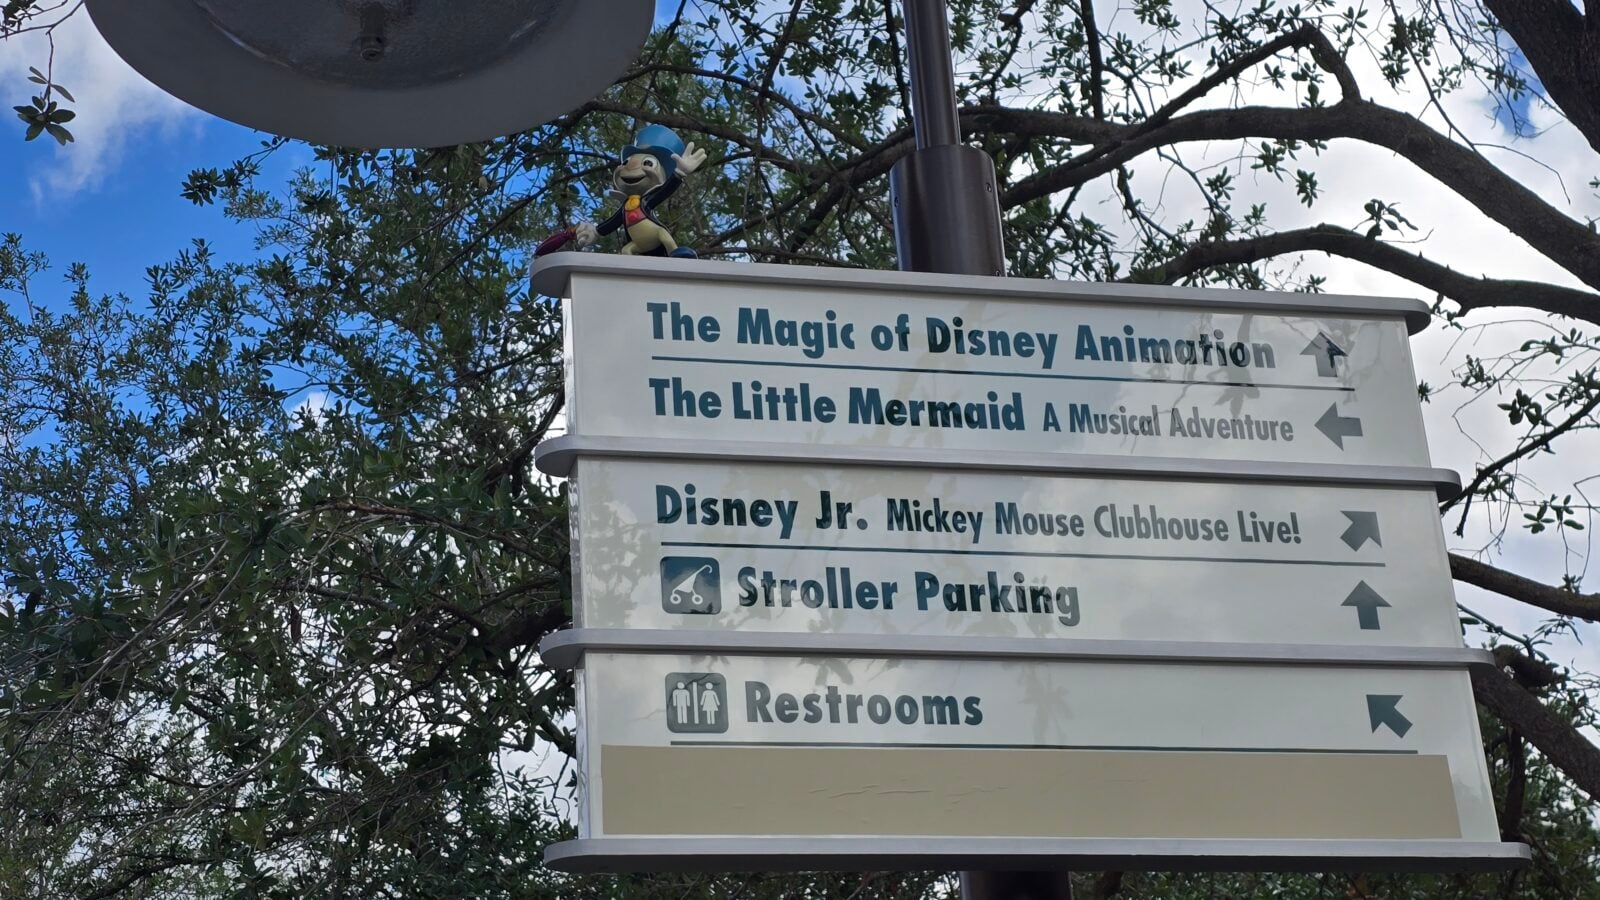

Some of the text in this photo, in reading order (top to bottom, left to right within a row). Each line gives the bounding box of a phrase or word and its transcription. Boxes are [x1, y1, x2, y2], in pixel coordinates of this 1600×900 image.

[647, 302, 1276, 369] The Magic of Disney Animation
[648, 377, 1294, 442] The Little Mermaid A Musical Adventure
[655, 483, 1302, 545] Disney Jr. Mickey Mouse Clubhouse Live!
[737, 566, 1081, 627] Stroller Parking
[745, 681, 984, 726] Restrooms
